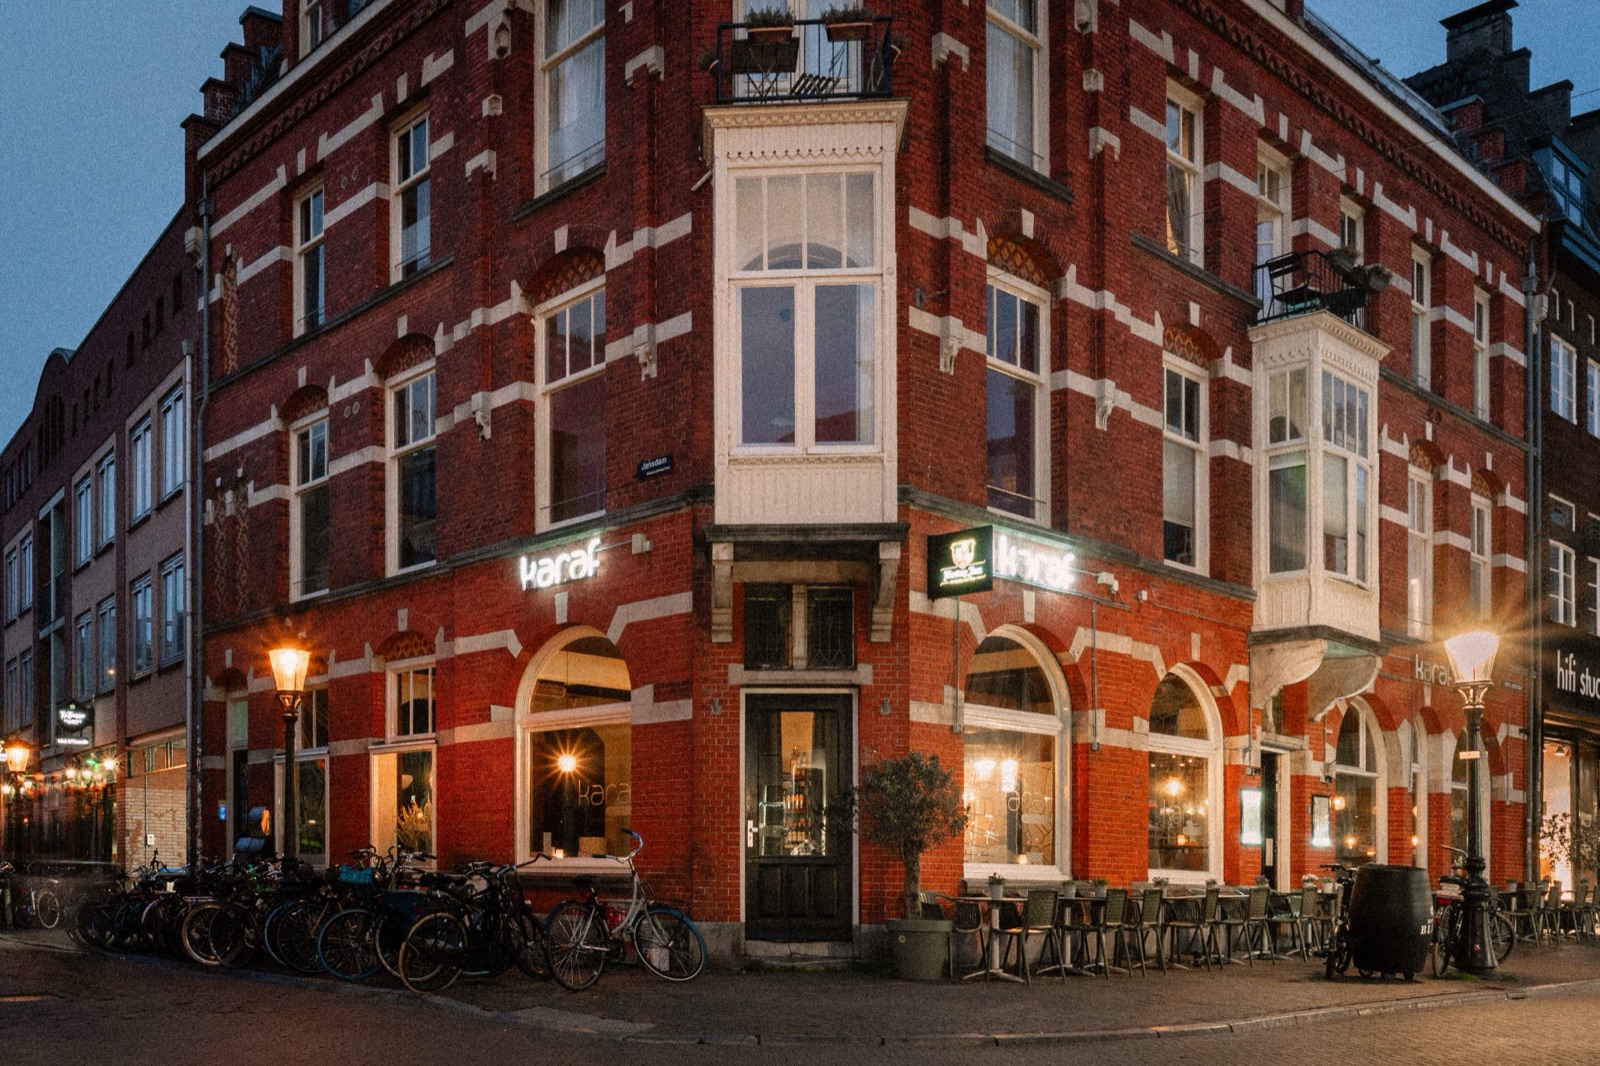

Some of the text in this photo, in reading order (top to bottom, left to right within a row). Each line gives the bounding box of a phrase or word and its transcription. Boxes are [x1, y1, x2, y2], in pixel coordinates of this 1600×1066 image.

[520, 536, 601, 591] karaf
[998, 534, 1076, 590] karaf
[1556, 649, 1577, 693] hifi
